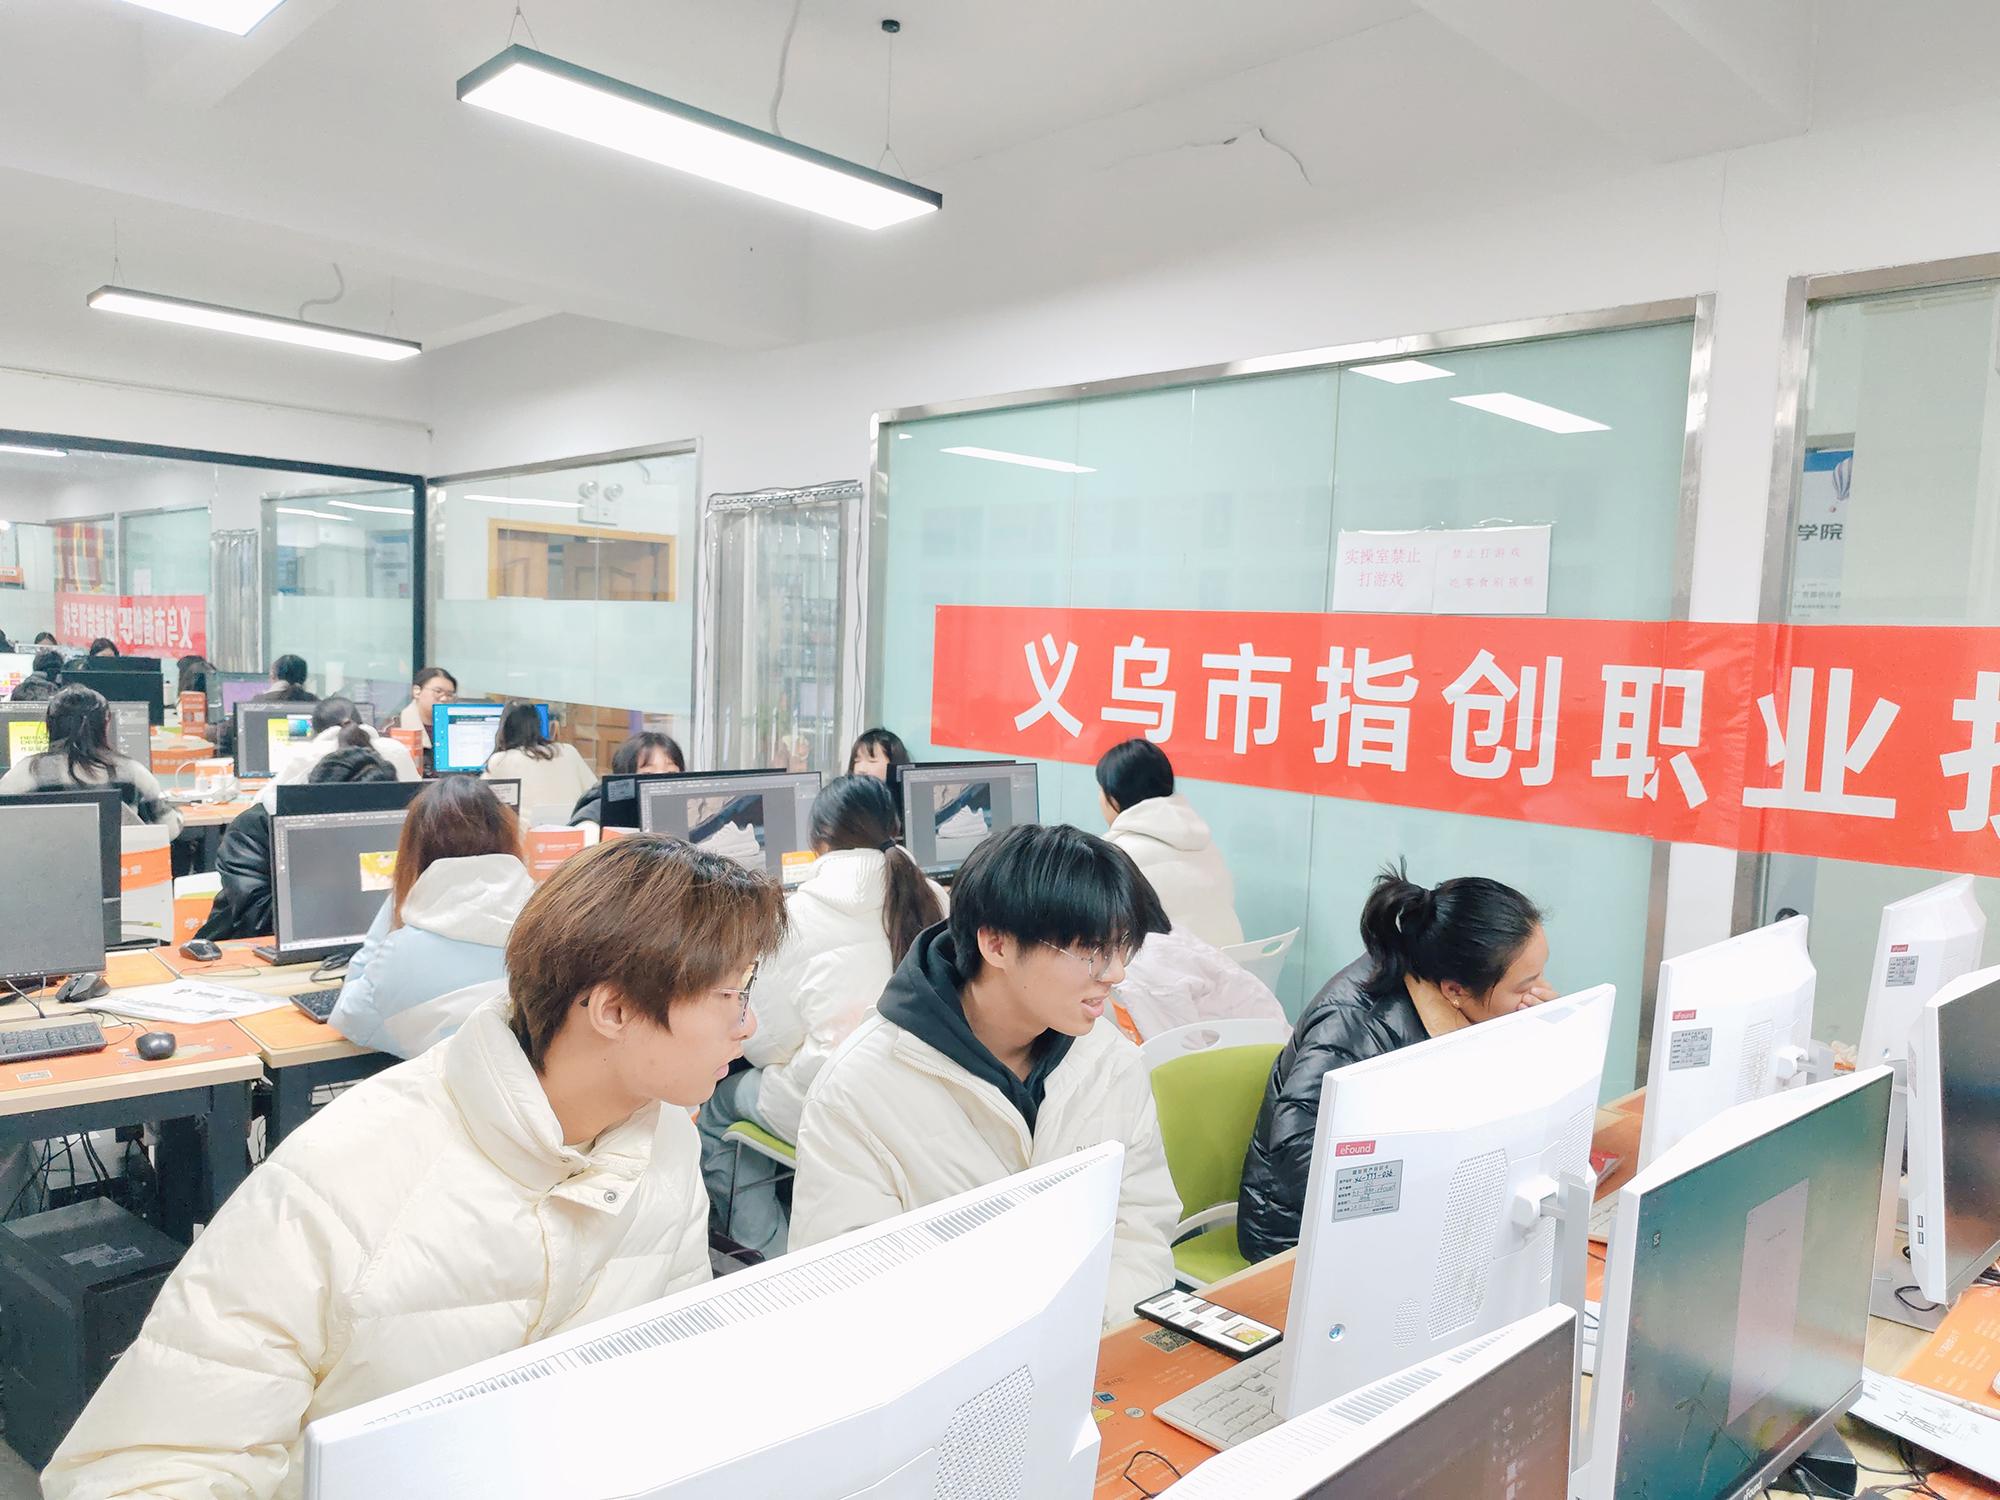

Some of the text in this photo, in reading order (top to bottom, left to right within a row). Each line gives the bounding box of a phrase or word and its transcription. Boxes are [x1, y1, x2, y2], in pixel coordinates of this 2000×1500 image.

[1797, 523, 1843, 541] 学院
[1344, 546, 1421, 565] 实操室禁止
[1359, 570, 1405, 588] 打游戏
[1340, 1144, 1371, 1154] eFound
